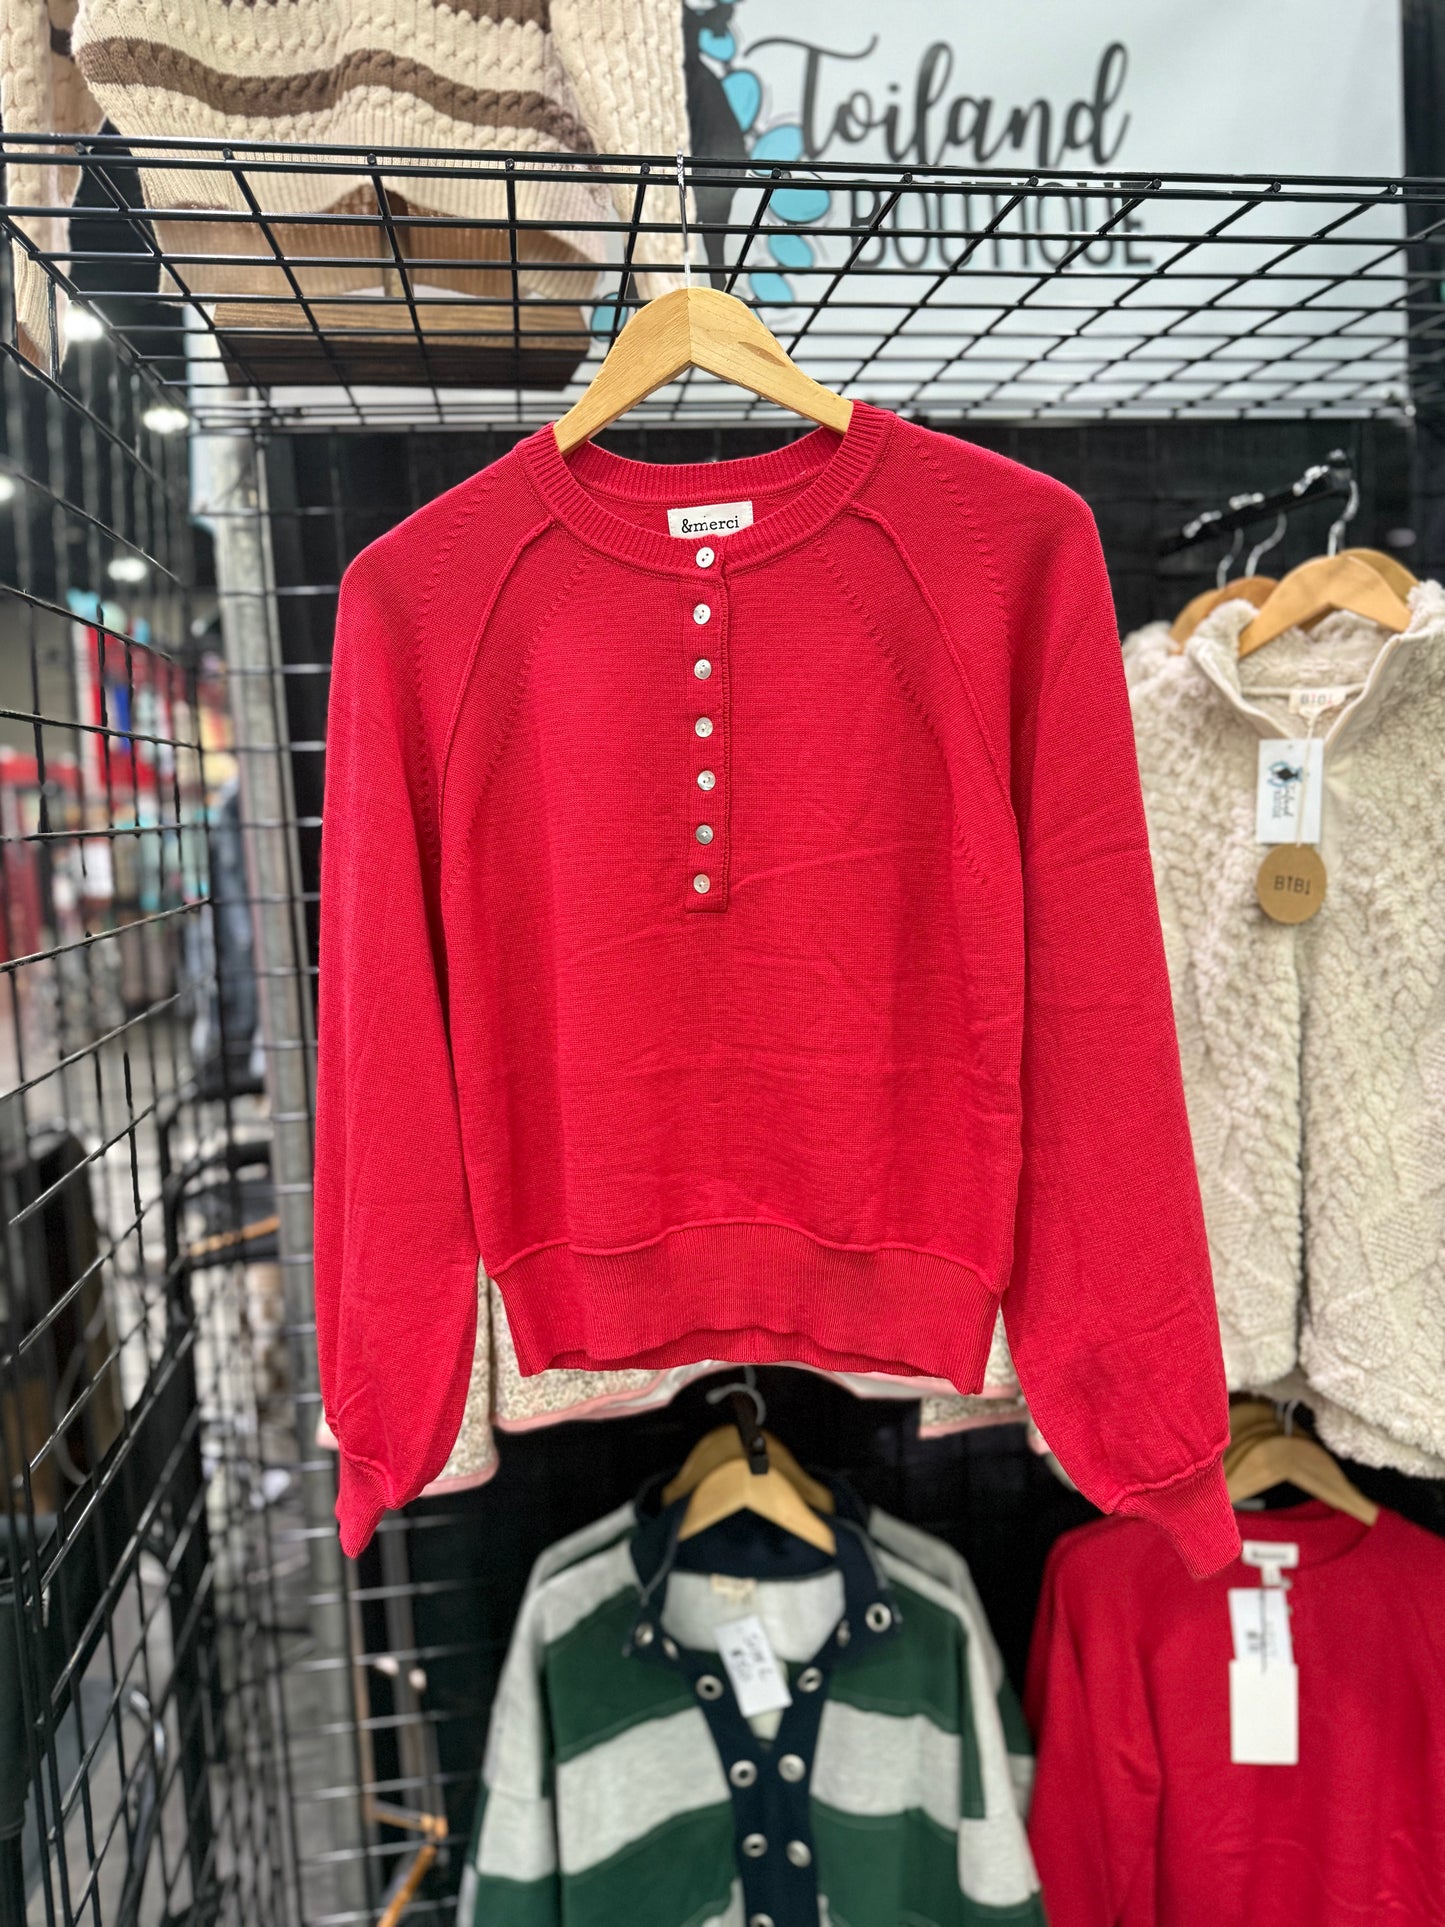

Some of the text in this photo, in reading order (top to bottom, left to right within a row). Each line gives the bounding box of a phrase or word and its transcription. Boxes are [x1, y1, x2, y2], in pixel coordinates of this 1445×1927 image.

[742, 33, 1132, 168] Toiland
[849, 178, 1154, 269] BOUTIQUE
[681, 515, 740, 533] &merci
